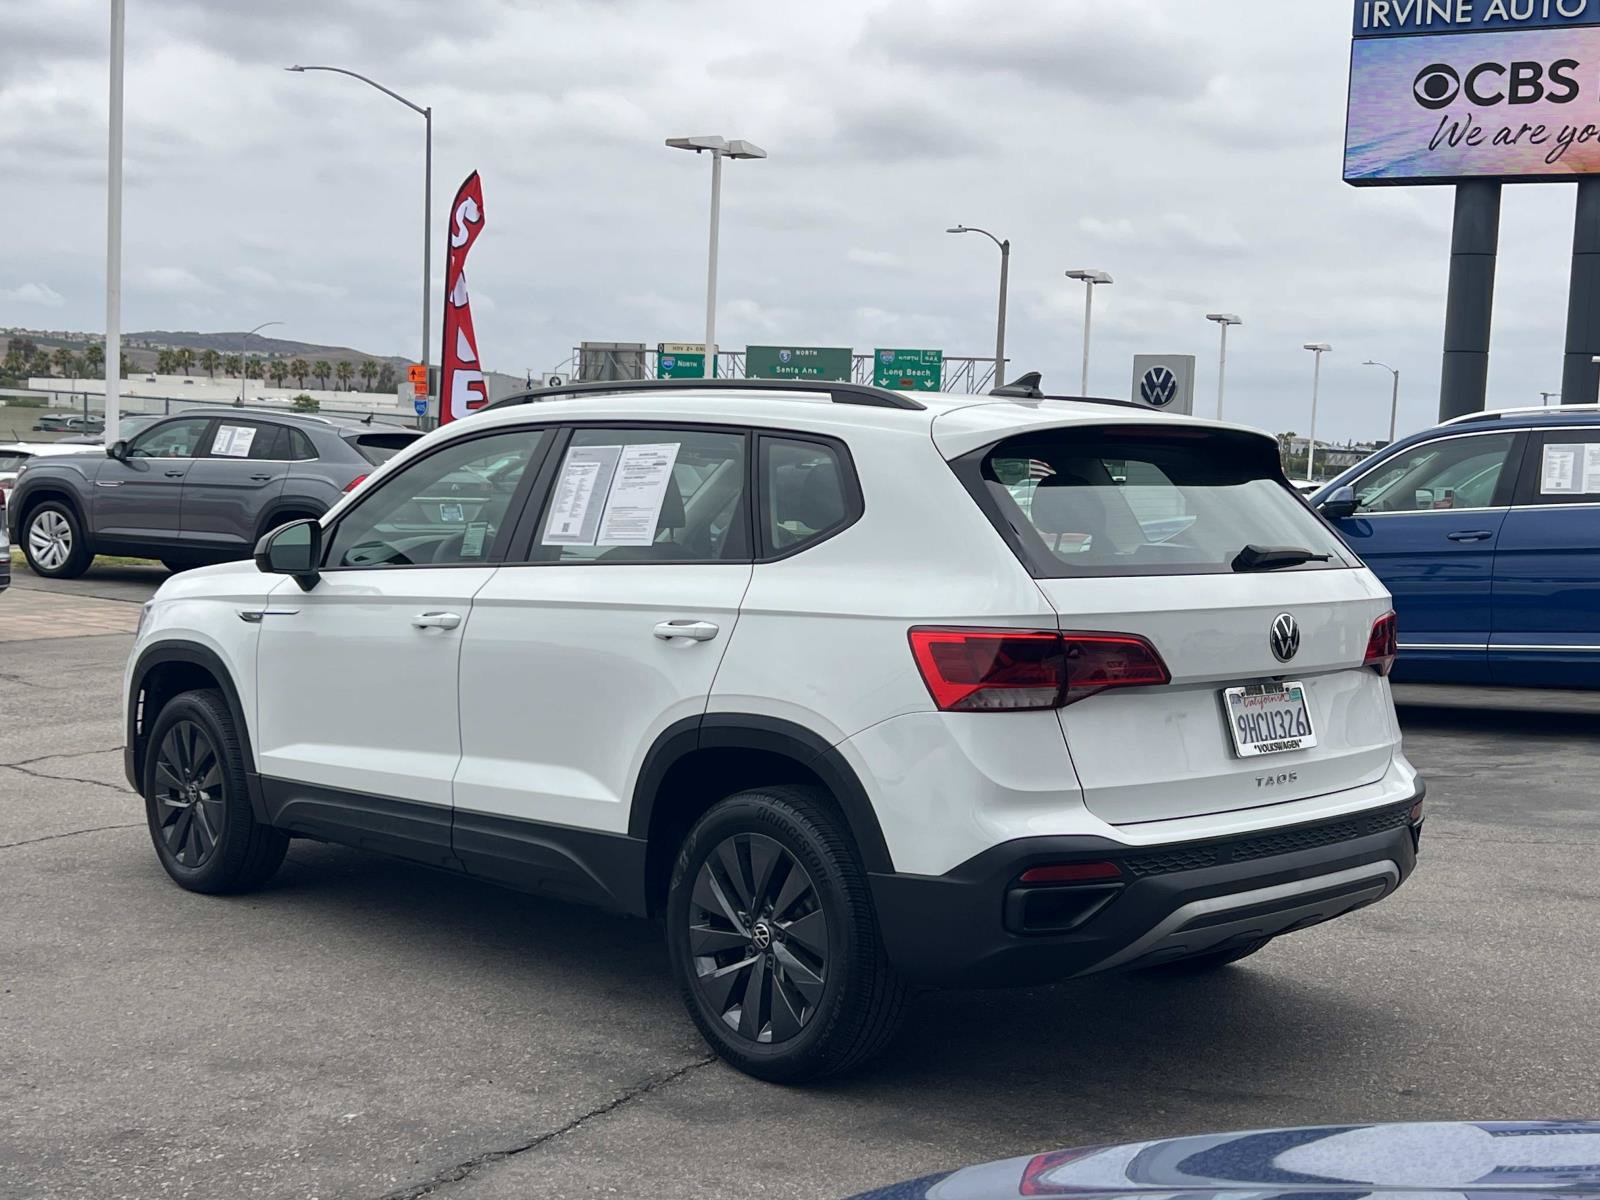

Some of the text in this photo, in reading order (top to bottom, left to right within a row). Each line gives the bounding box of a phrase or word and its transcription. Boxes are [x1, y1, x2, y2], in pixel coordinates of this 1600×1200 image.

[1362, 0, 1588, 28] IRVINE AUTO
[1464, 59, 1580, 107] CBS
[1428, 112, 1600, 164] We are yo
[775, 366, 799, 374] Santa
[883, 367, 931, 377] Long Beach
[1237, 707, 1307, 744] 9HCU326
